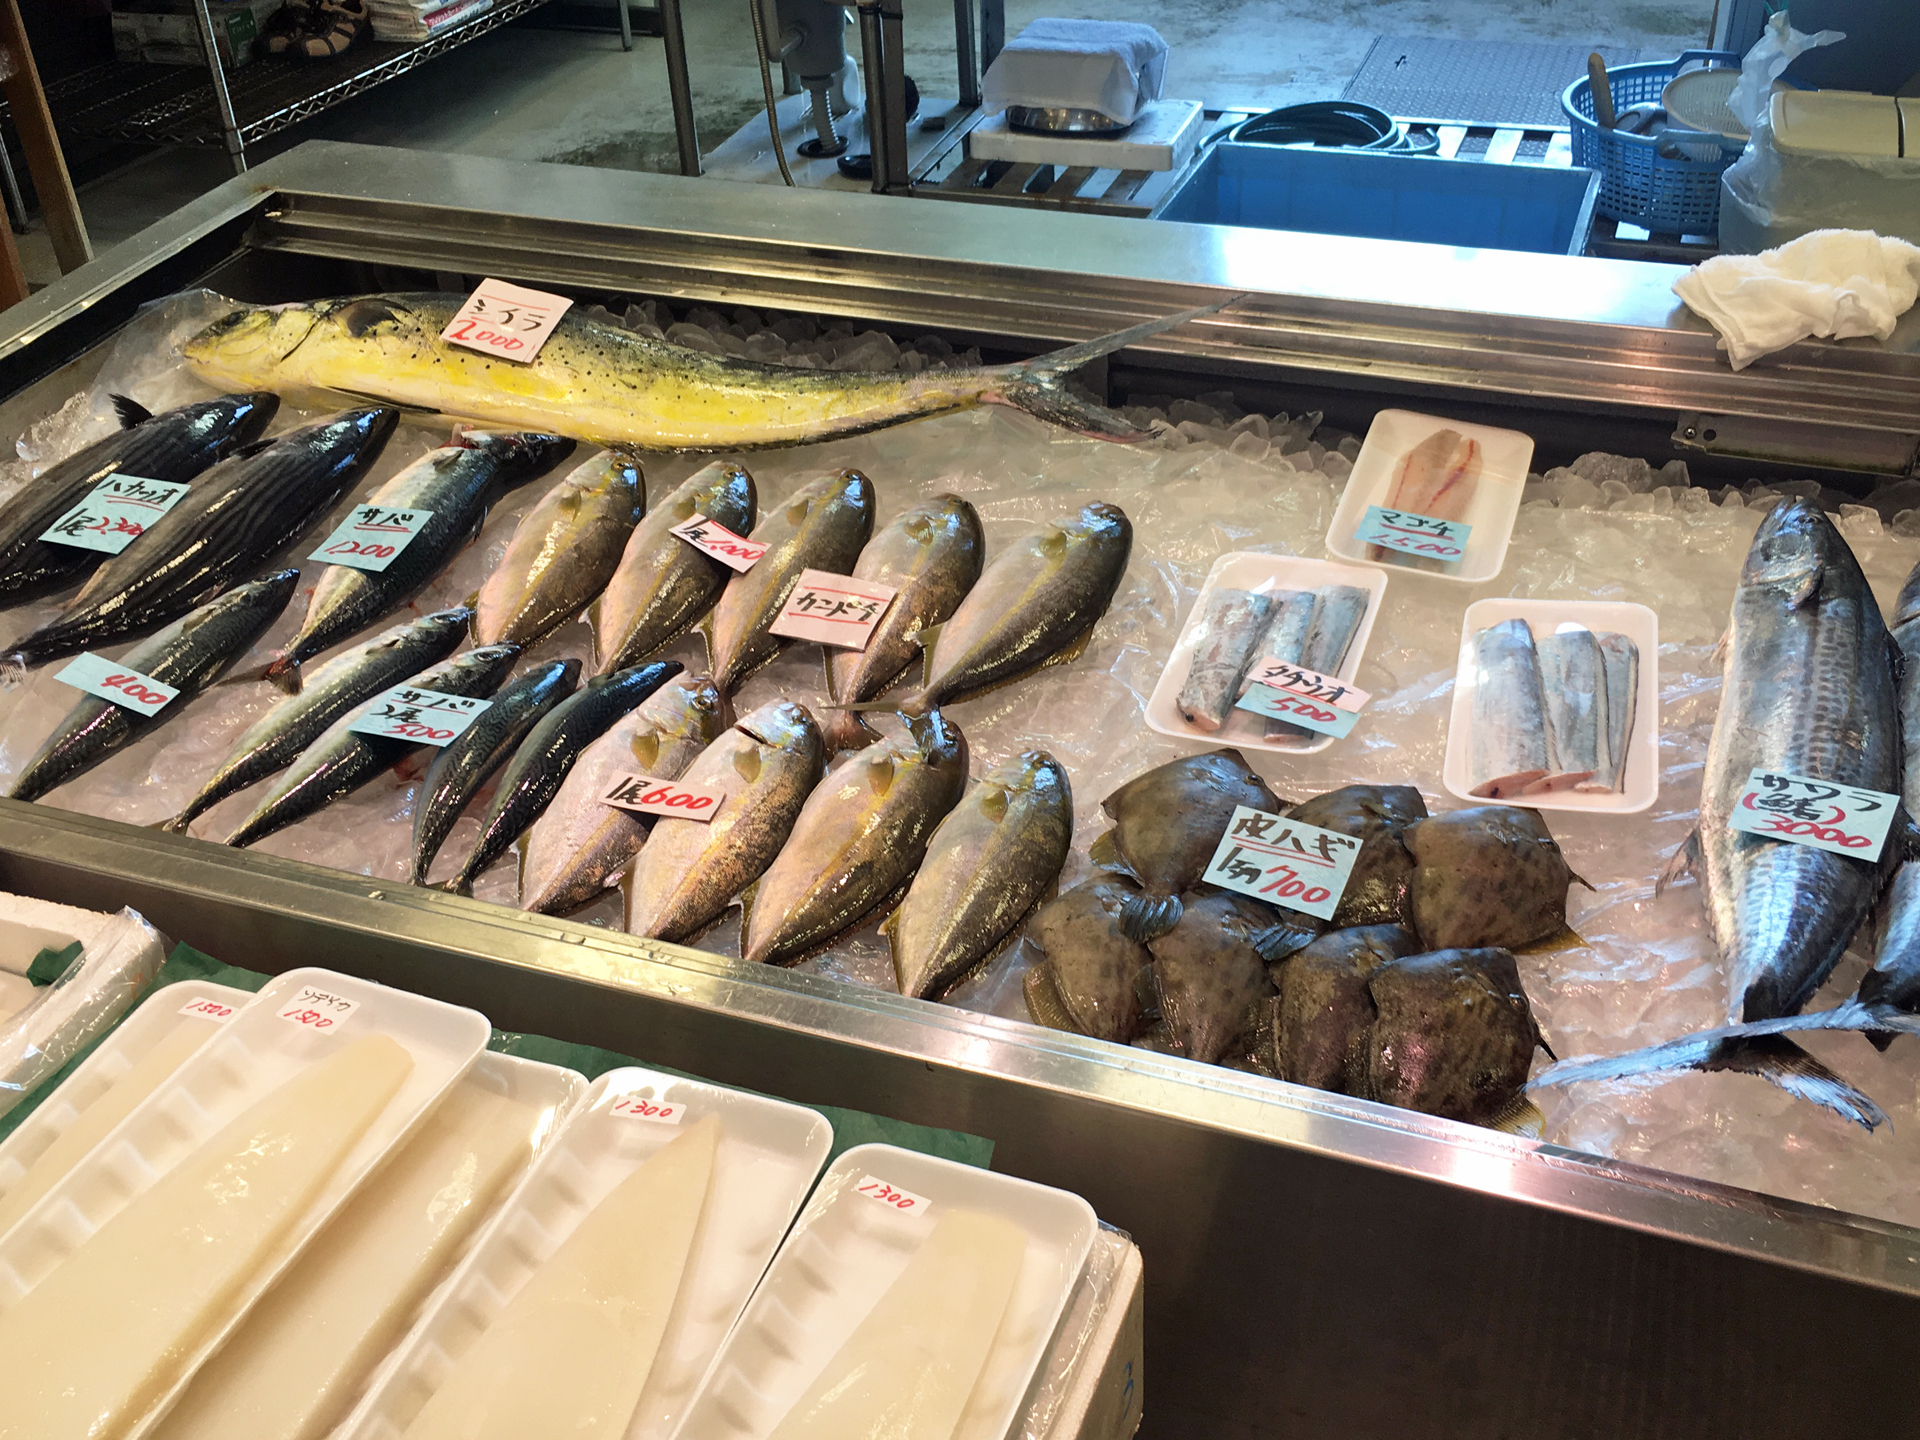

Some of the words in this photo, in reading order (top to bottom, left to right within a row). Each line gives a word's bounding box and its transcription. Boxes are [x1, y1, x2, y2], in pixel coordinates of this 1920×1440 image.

[468, 298, 547, 332] シイラ
[449, 319, 524, 351] 2000
[357, 508, 414, 526] サバ
[1379, 509, 1455, 537] マゴチ
[100, 673, 169, 705] 400
[394, 690, 476, 709] サバ
[1265, 696, 1338, 722] 500
[382, 722, 455, 739] 500
[1753, 774, 1883, 812] サワラ
[1230, 813, 1356, 864] 皮ハギ
[1750, 812, 1873, 848] 3000
[185, 1001, 233, 1017] 1500
[282, 1008, 334, 1028] 1500
[614, 1099, 674, 1118] 1300
[857, 1183, 915, 1209] 1300
